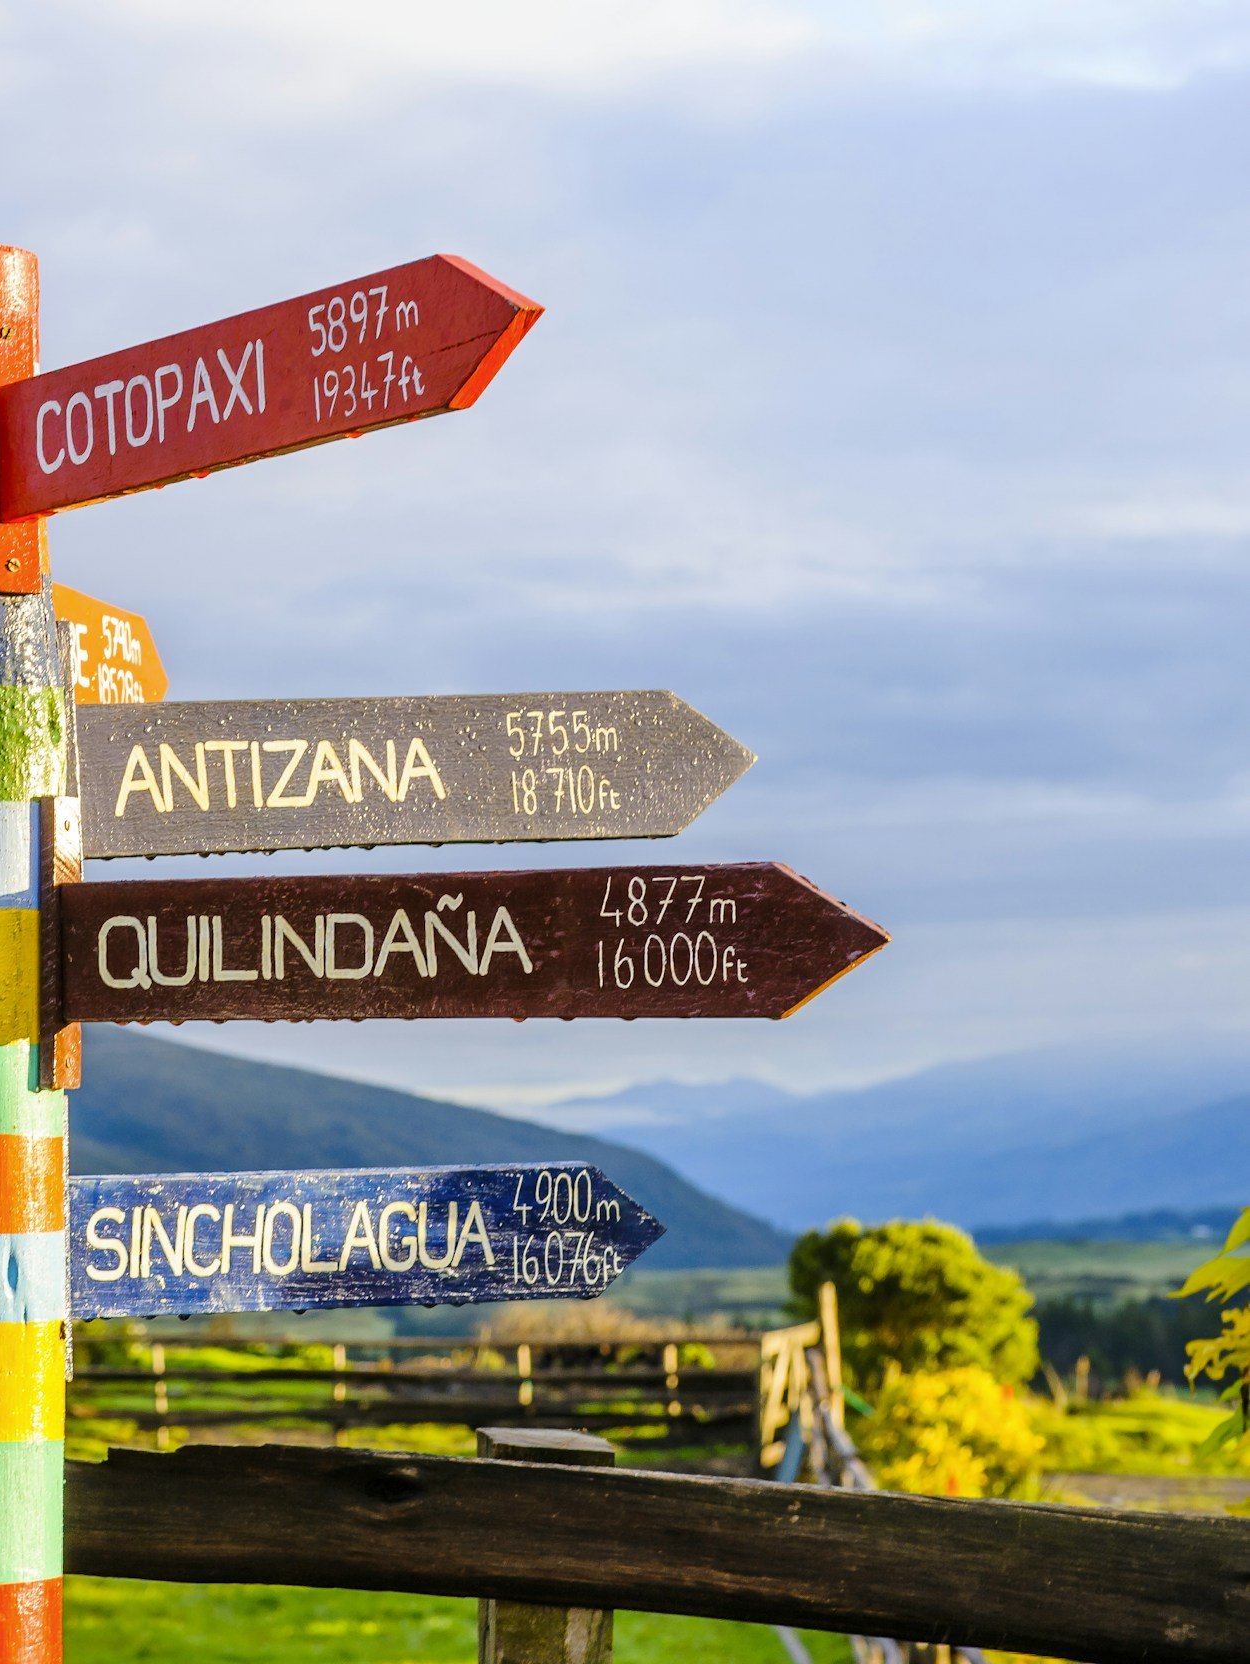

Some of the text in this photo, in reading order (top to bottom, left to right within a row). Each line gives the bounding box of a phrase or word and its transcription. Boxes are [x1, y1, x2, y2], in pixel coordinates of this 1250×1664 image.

[36, 339, 266, 474] COTOPAXI
[313, 351, 426, 423] 19347ft
[506, 710, 618, 757] 5755m
[114, 737, 446, 817] ANTIZANA
[98, 892, 533, 990] QUILINDAÑA
[86, 1200, 496, 1281] SINCHOLAGUA
